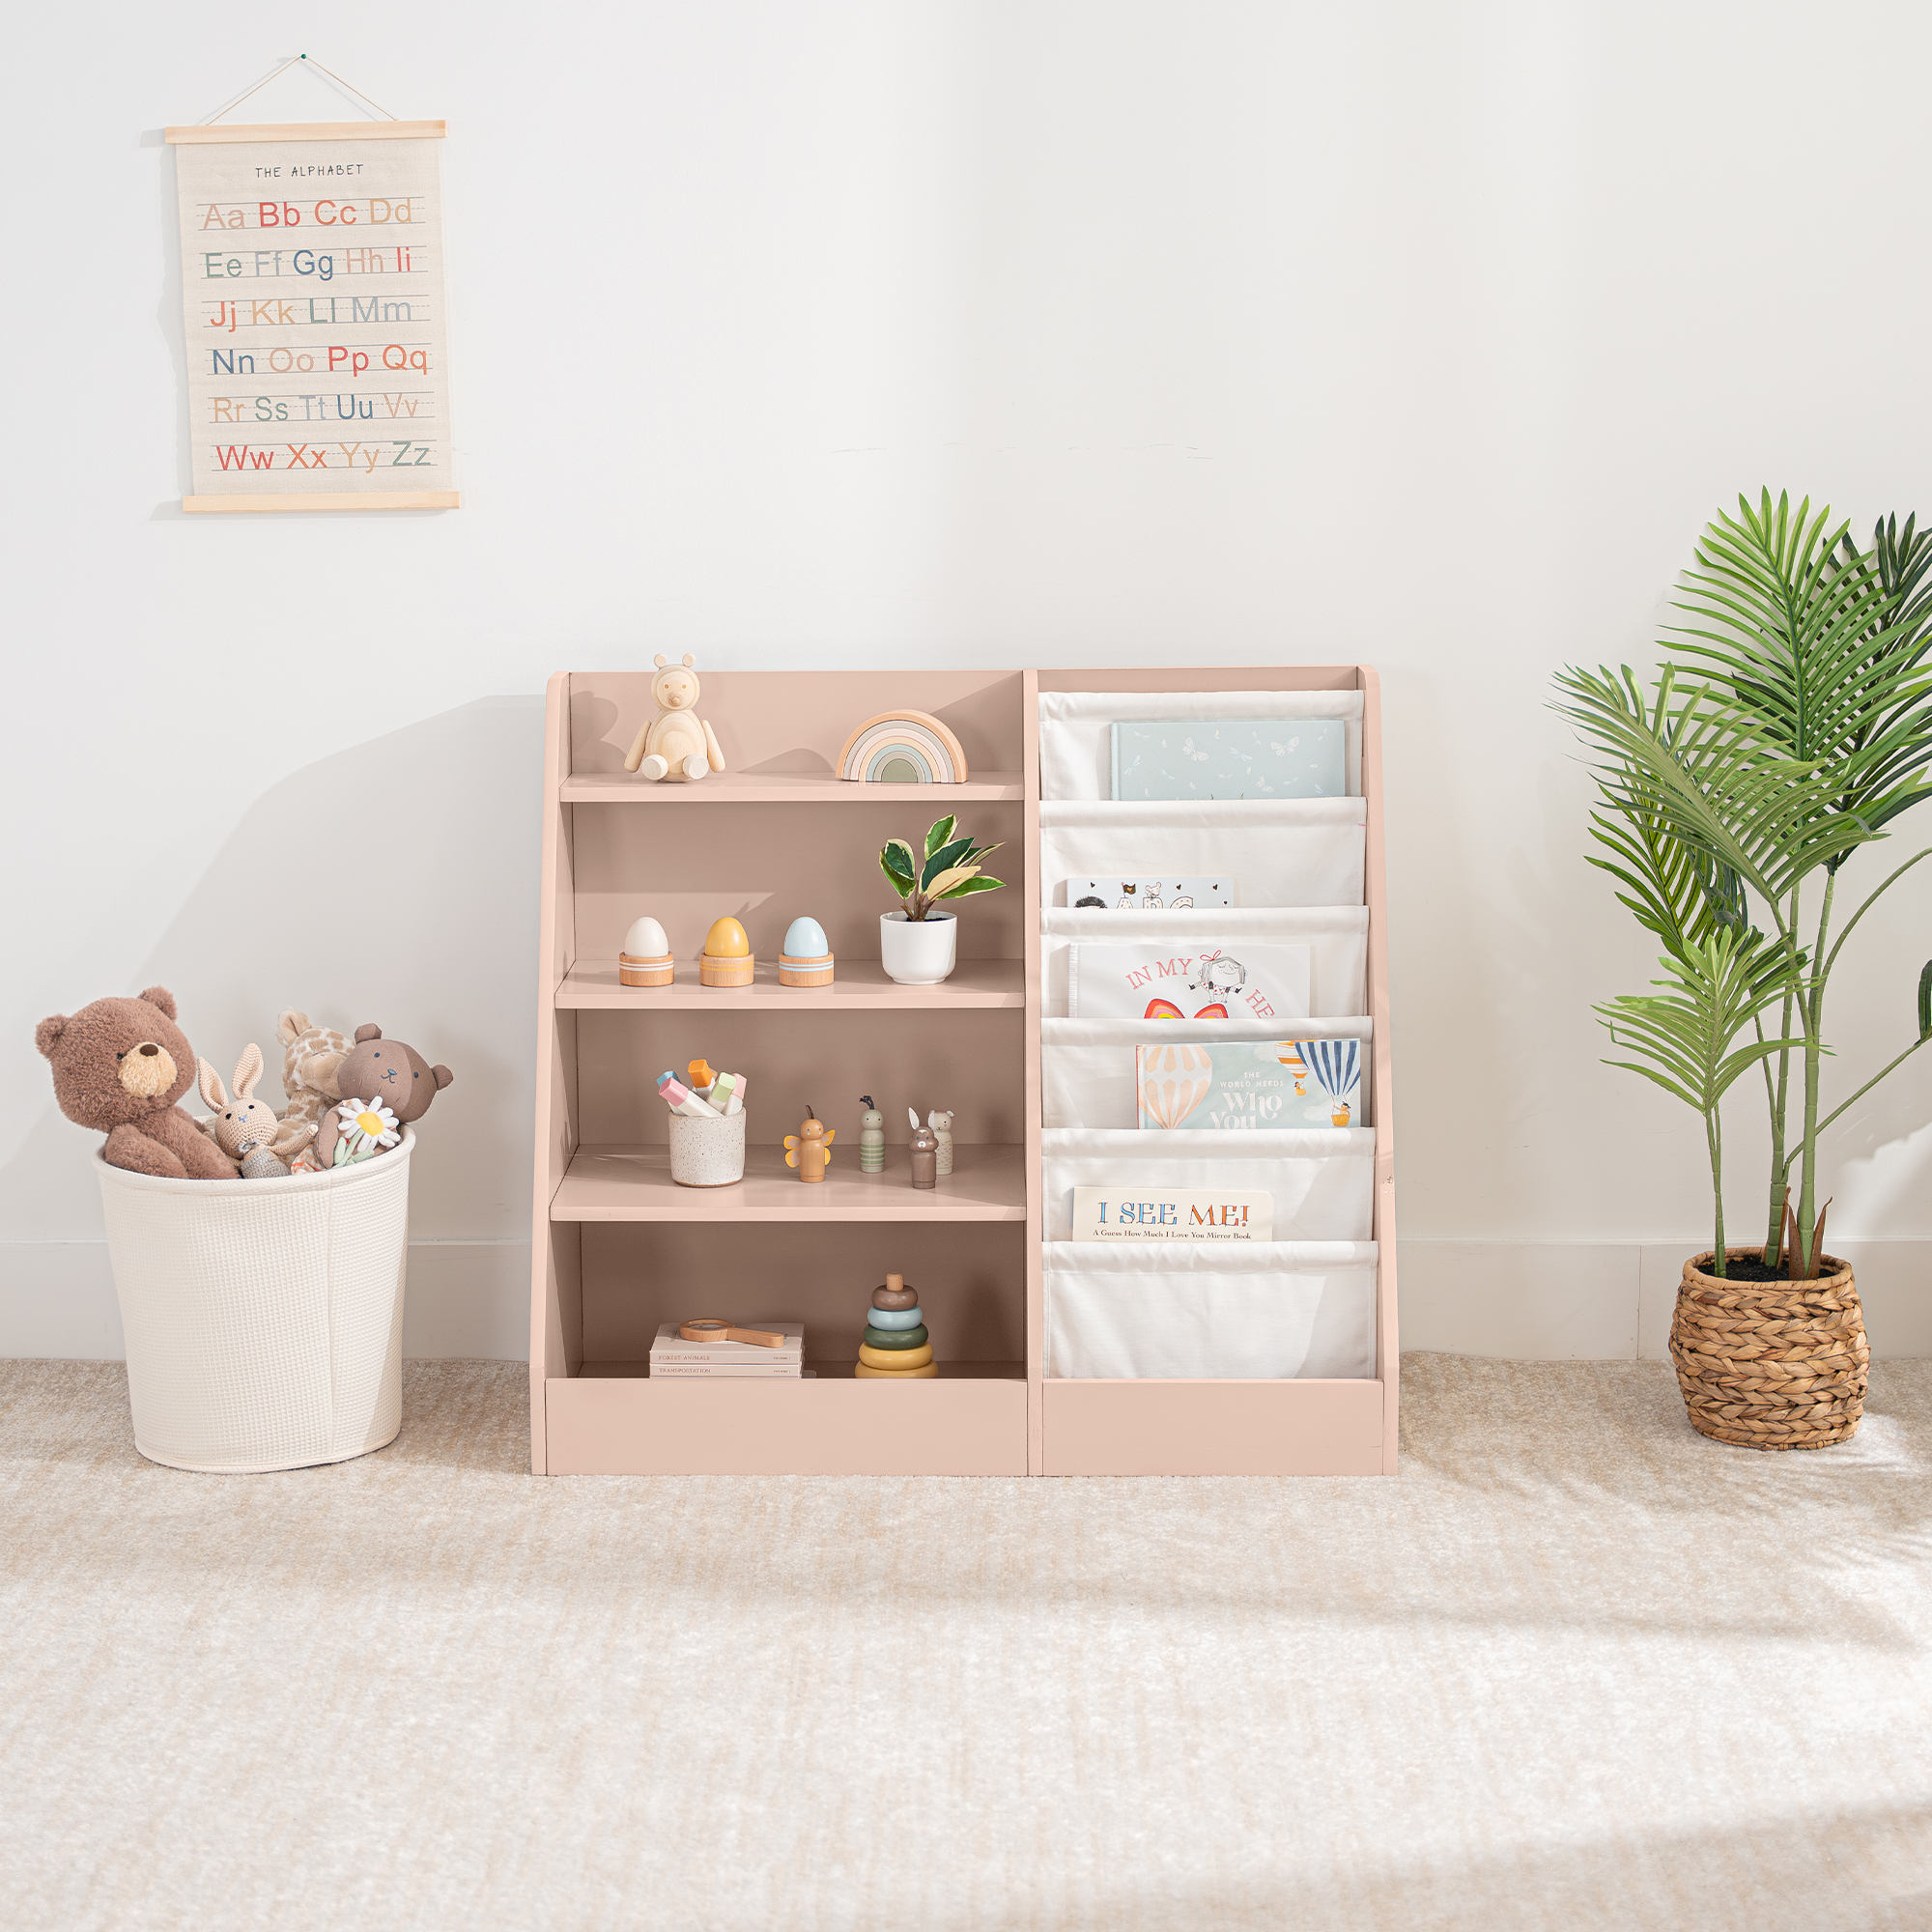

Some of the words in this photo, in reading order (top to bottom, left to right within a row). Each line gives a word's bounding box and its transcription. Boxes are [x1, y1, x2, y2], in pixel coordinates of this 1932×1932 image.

[256, 167, 281, 178] THE
[292, 164, 364, 177] ALPHABET
[203, 205, 245, 229] Aa
[259, 202, 301, 227] Bb
[314, 201, 357, 226] Cc
[370, 198, 412, 223] Dd
[206, 253, 242, 277] Ee
[255, 250, 282, 276] Ff
[293, 249, 333, 280] Gg
[347, 248, 384, 273] Hh
[397, 247, 411, 271] Ii
[211, 301, 237, 332] Jj
[252, 299, 295, 324] Kk
[310, 298, 335, 324] Ll
[353, 298, 412, 322] Mm
[213, 350, 255, 374] Nn
[270, 349, 314, 372] Oo
[328, 347, 369, 377] Pp
[383, 345, 428, 374] Qq
[214, 398, 244, 422] Rr
[255, 396, 288, 421] Ss
[299, 395, 327, 419] Tt
[337, 394, 373, 419] Uu
[384, 393, 418, 417] Vv
[216, 445, 274, 470] Ww
[287, 444, 327, 469] Xx
[339, 443, 380, 473] Yy
[393, 441, 431, 466] Zz
[1125, 965, 1152, 989] IN
[1156, 958, 1192, 978] MY
[1209, 1111, 1256, 1129] You
[1223, 1092, 1282, 1120] Who
[1098, 1202, 1108, 1224] I
[1120, 1202, 1178, 1225] SEE
[1189, 1205, 1250, 1227] ME!
